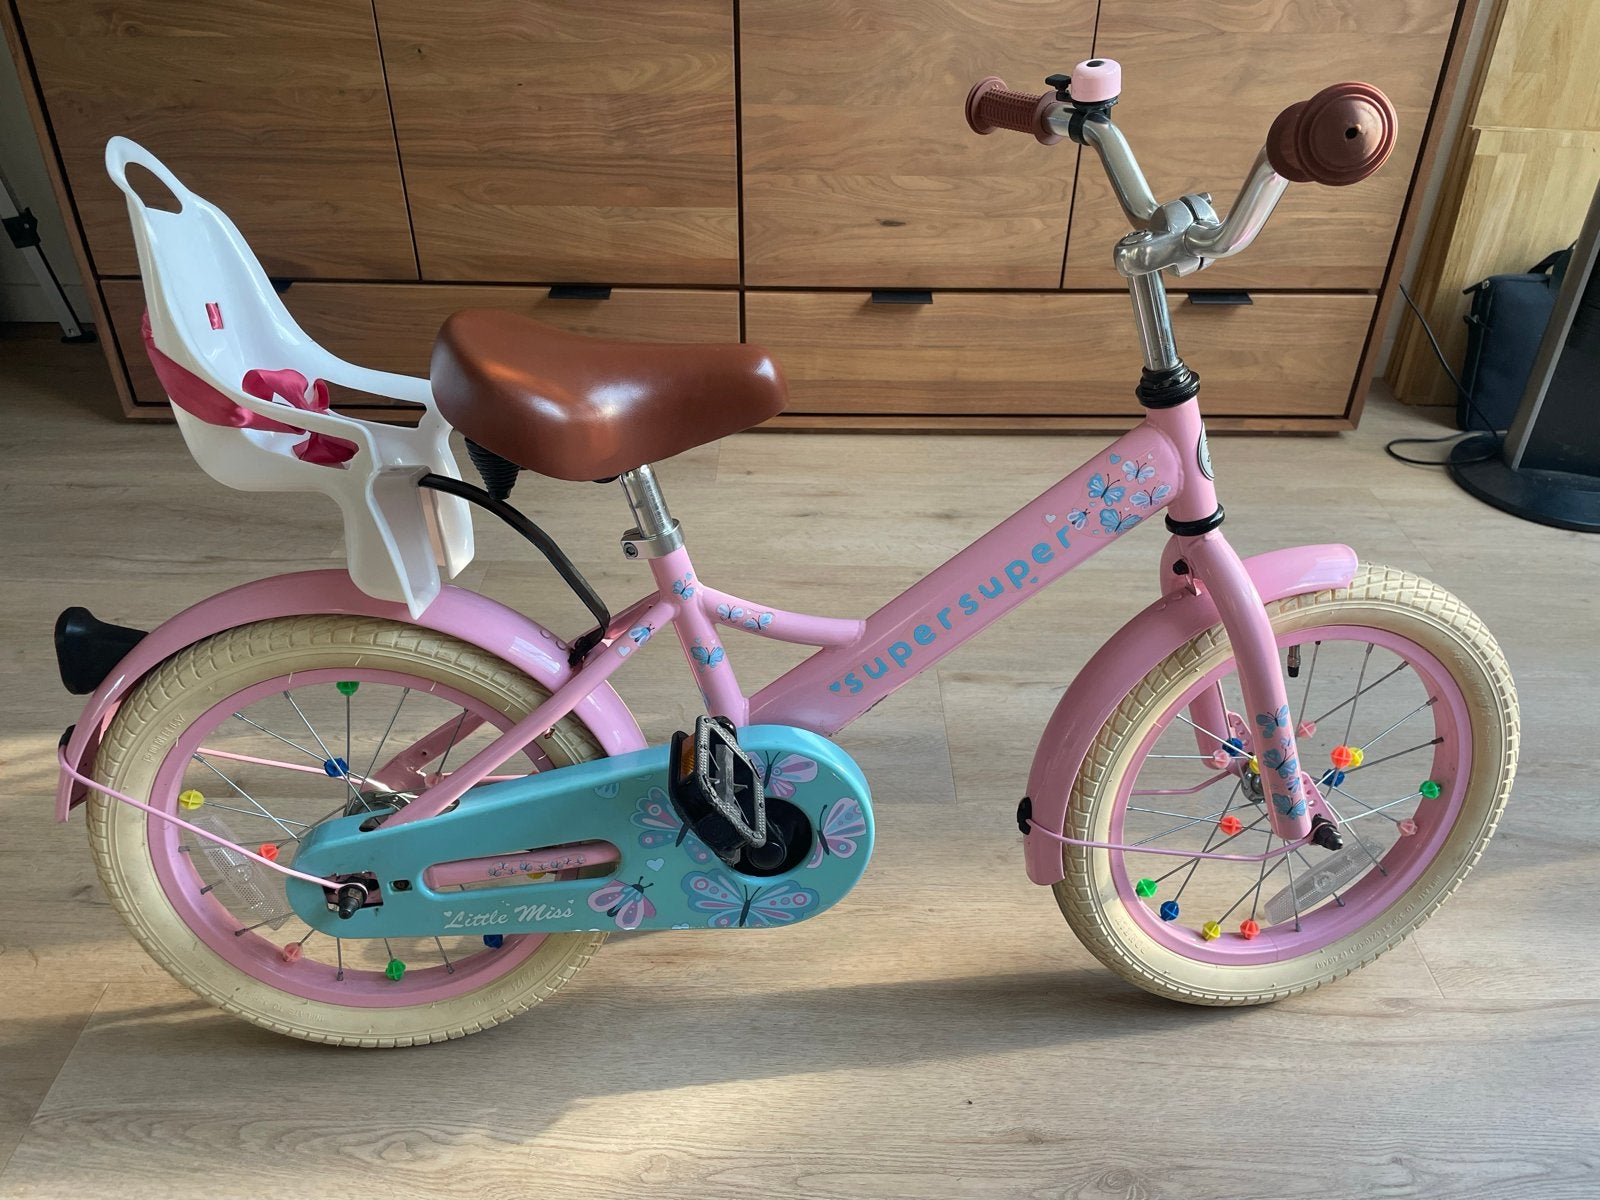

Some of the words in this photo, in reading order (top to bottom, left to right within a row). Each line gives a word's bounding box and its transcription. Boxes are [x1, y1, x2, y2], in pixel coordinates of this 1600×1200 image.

[844, 525, 1076, 694] supersuper
[443, 910, 509, 929] Little
[514, 903, 574, 922] Miss
